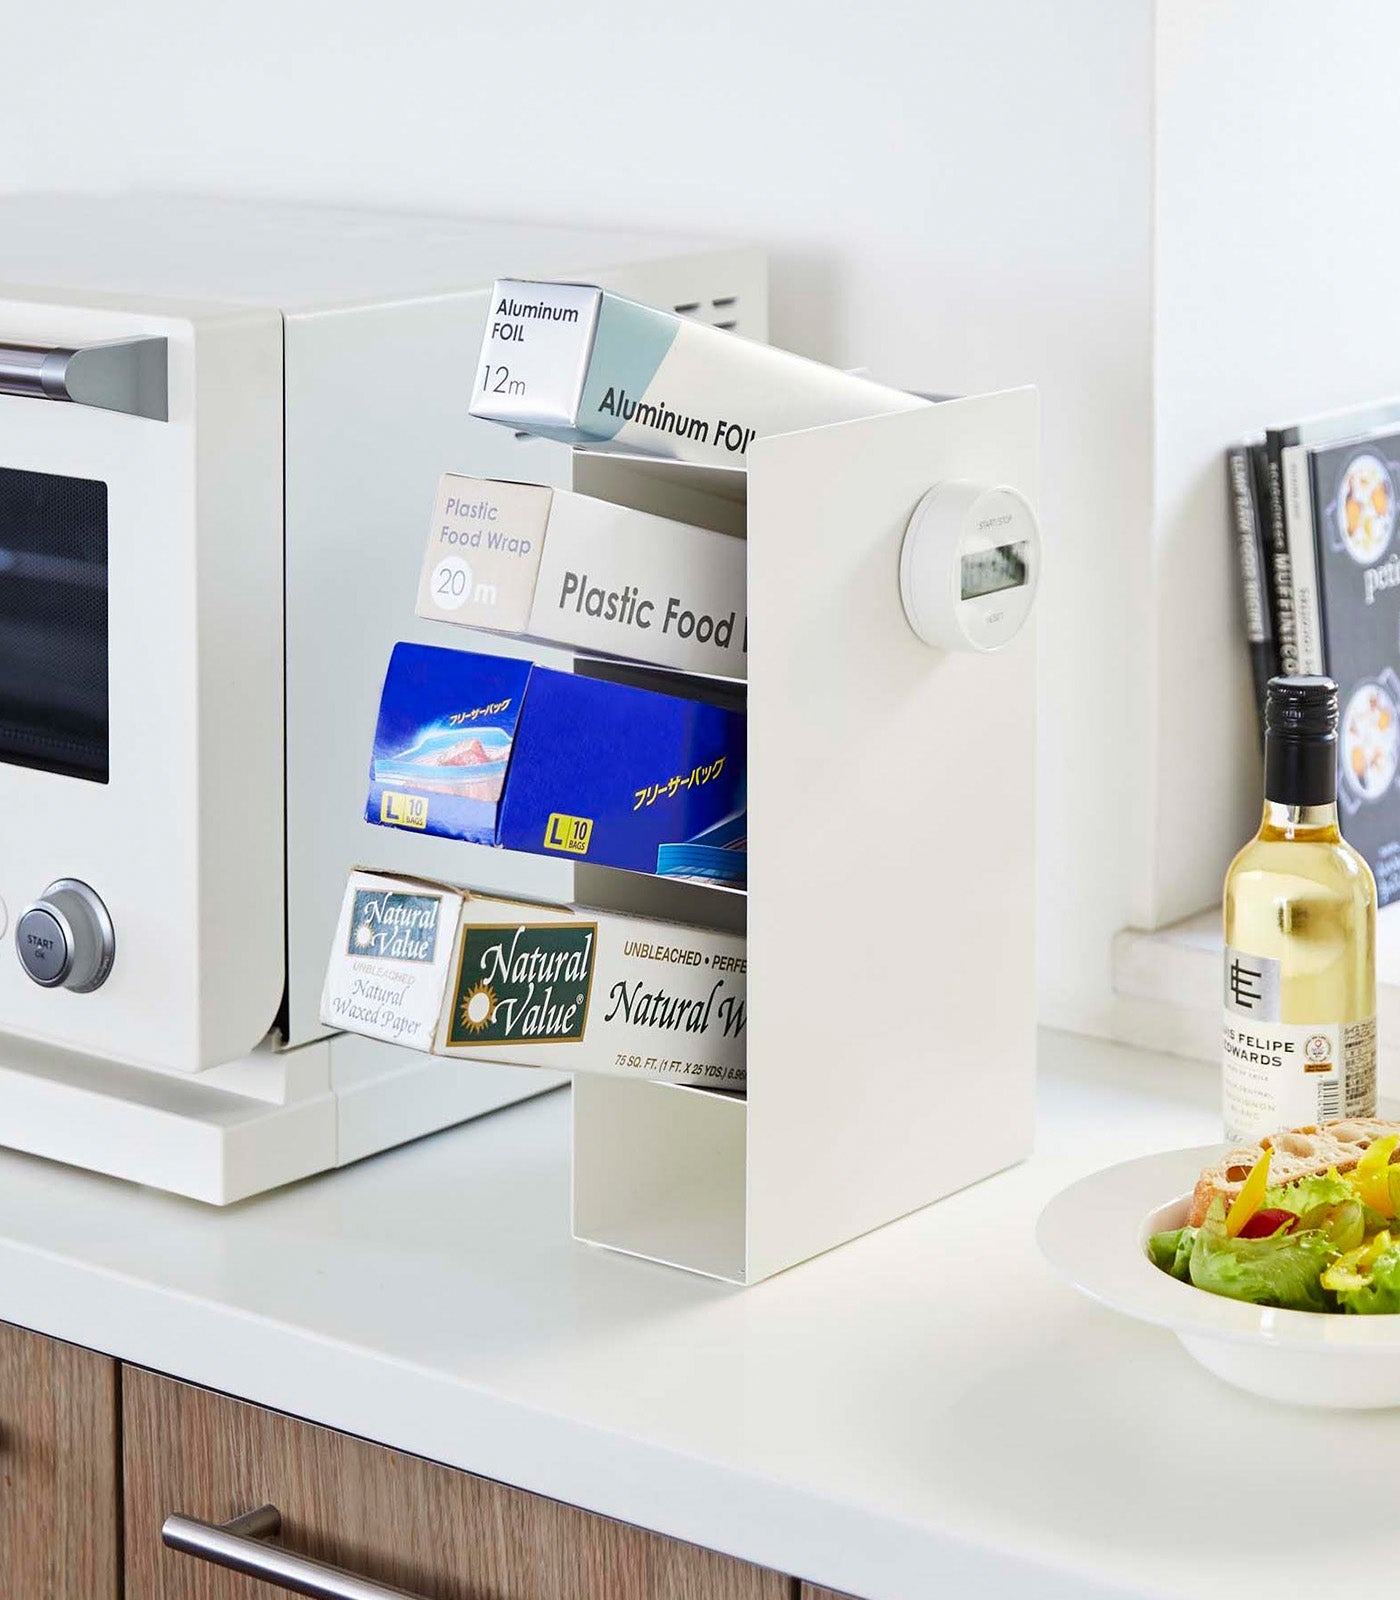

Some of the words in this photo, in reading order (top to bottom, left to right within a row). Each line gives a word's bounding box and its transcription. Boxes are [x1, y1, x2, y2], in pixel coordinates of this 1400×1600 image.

[496, 299, 579, 323] Aluminum
[491, 323, 525, 342] FOIL
[598, 387, 708, 442] Aluminum
[445, 499, 498, 521] Plastic
[440, 526, 481, 548] Food
[487, 531, 531, 556] Wrap
[559, 572, 654, 629] Plastic
[662, 598, 736, 649] Food
[386, 796, 399, 820] L
[409, 799, 423, 817] 10
[405, 816, 424, 826] BAGS
[550, 818, 563, 846] L
[572, 821, 588, 841] 10
[568, 840, 586, 851] BAGS
[364, 891, 438, 927] Natural
[27, 934, 54, 950] START
[370, 925, 429, 959] Value
[624, 940, 702, 966] UNBLEACHED
[34, 950, 46, 960] OK
[480, 926, 593, 986] Natural
[352, 961, 416, 986] UNBLEACHED
[352, 979, 410, 1006] Natural
[333, 998, 378, 1025] Waxed
[380, 1010, 421, 1038] Paper
[604, 979, 725, 1034] Natural
[1238, 1033, 1295, 1053] FELIPE
[615, 1055, 627, 1067] 75
[627, 1056, 641, 1068] SQ.
[644, 1058, 657, 1070] FT.
[669, 1061, 682, 1073] FT.
[683, 1063, 692, 1074] X
[692, 1064, 703, 1075] 25
